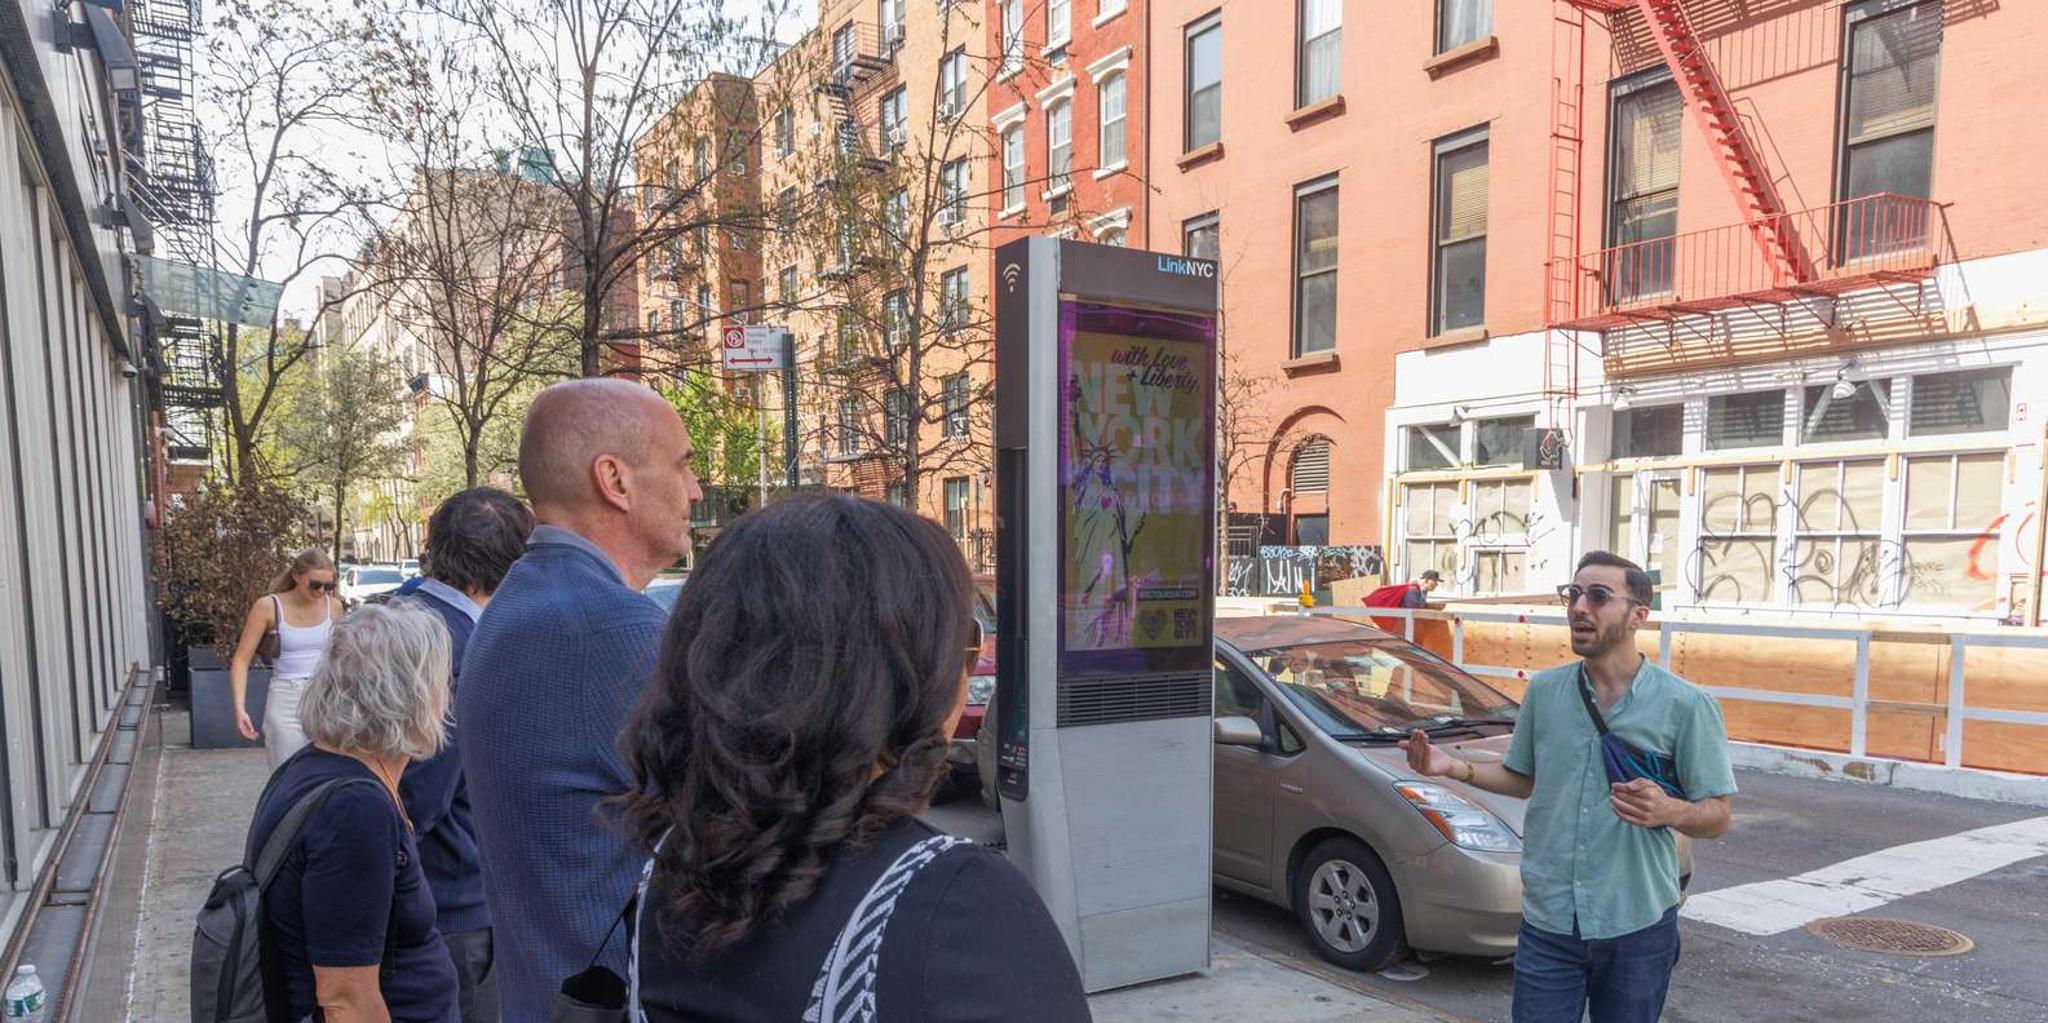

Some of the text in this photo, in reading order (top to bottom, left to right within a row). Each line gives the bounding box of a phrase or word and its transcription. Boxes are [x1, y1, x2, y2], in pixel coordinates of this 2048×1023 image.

[1158, 256, 1213, 278] LinkNYC
[1111, 345, 1149, 366] with
[1072, 360, 1174, 418] NEW
[1079, 412, 1205, 469] YORK
[1110, 464, 1205, 515] CITY
